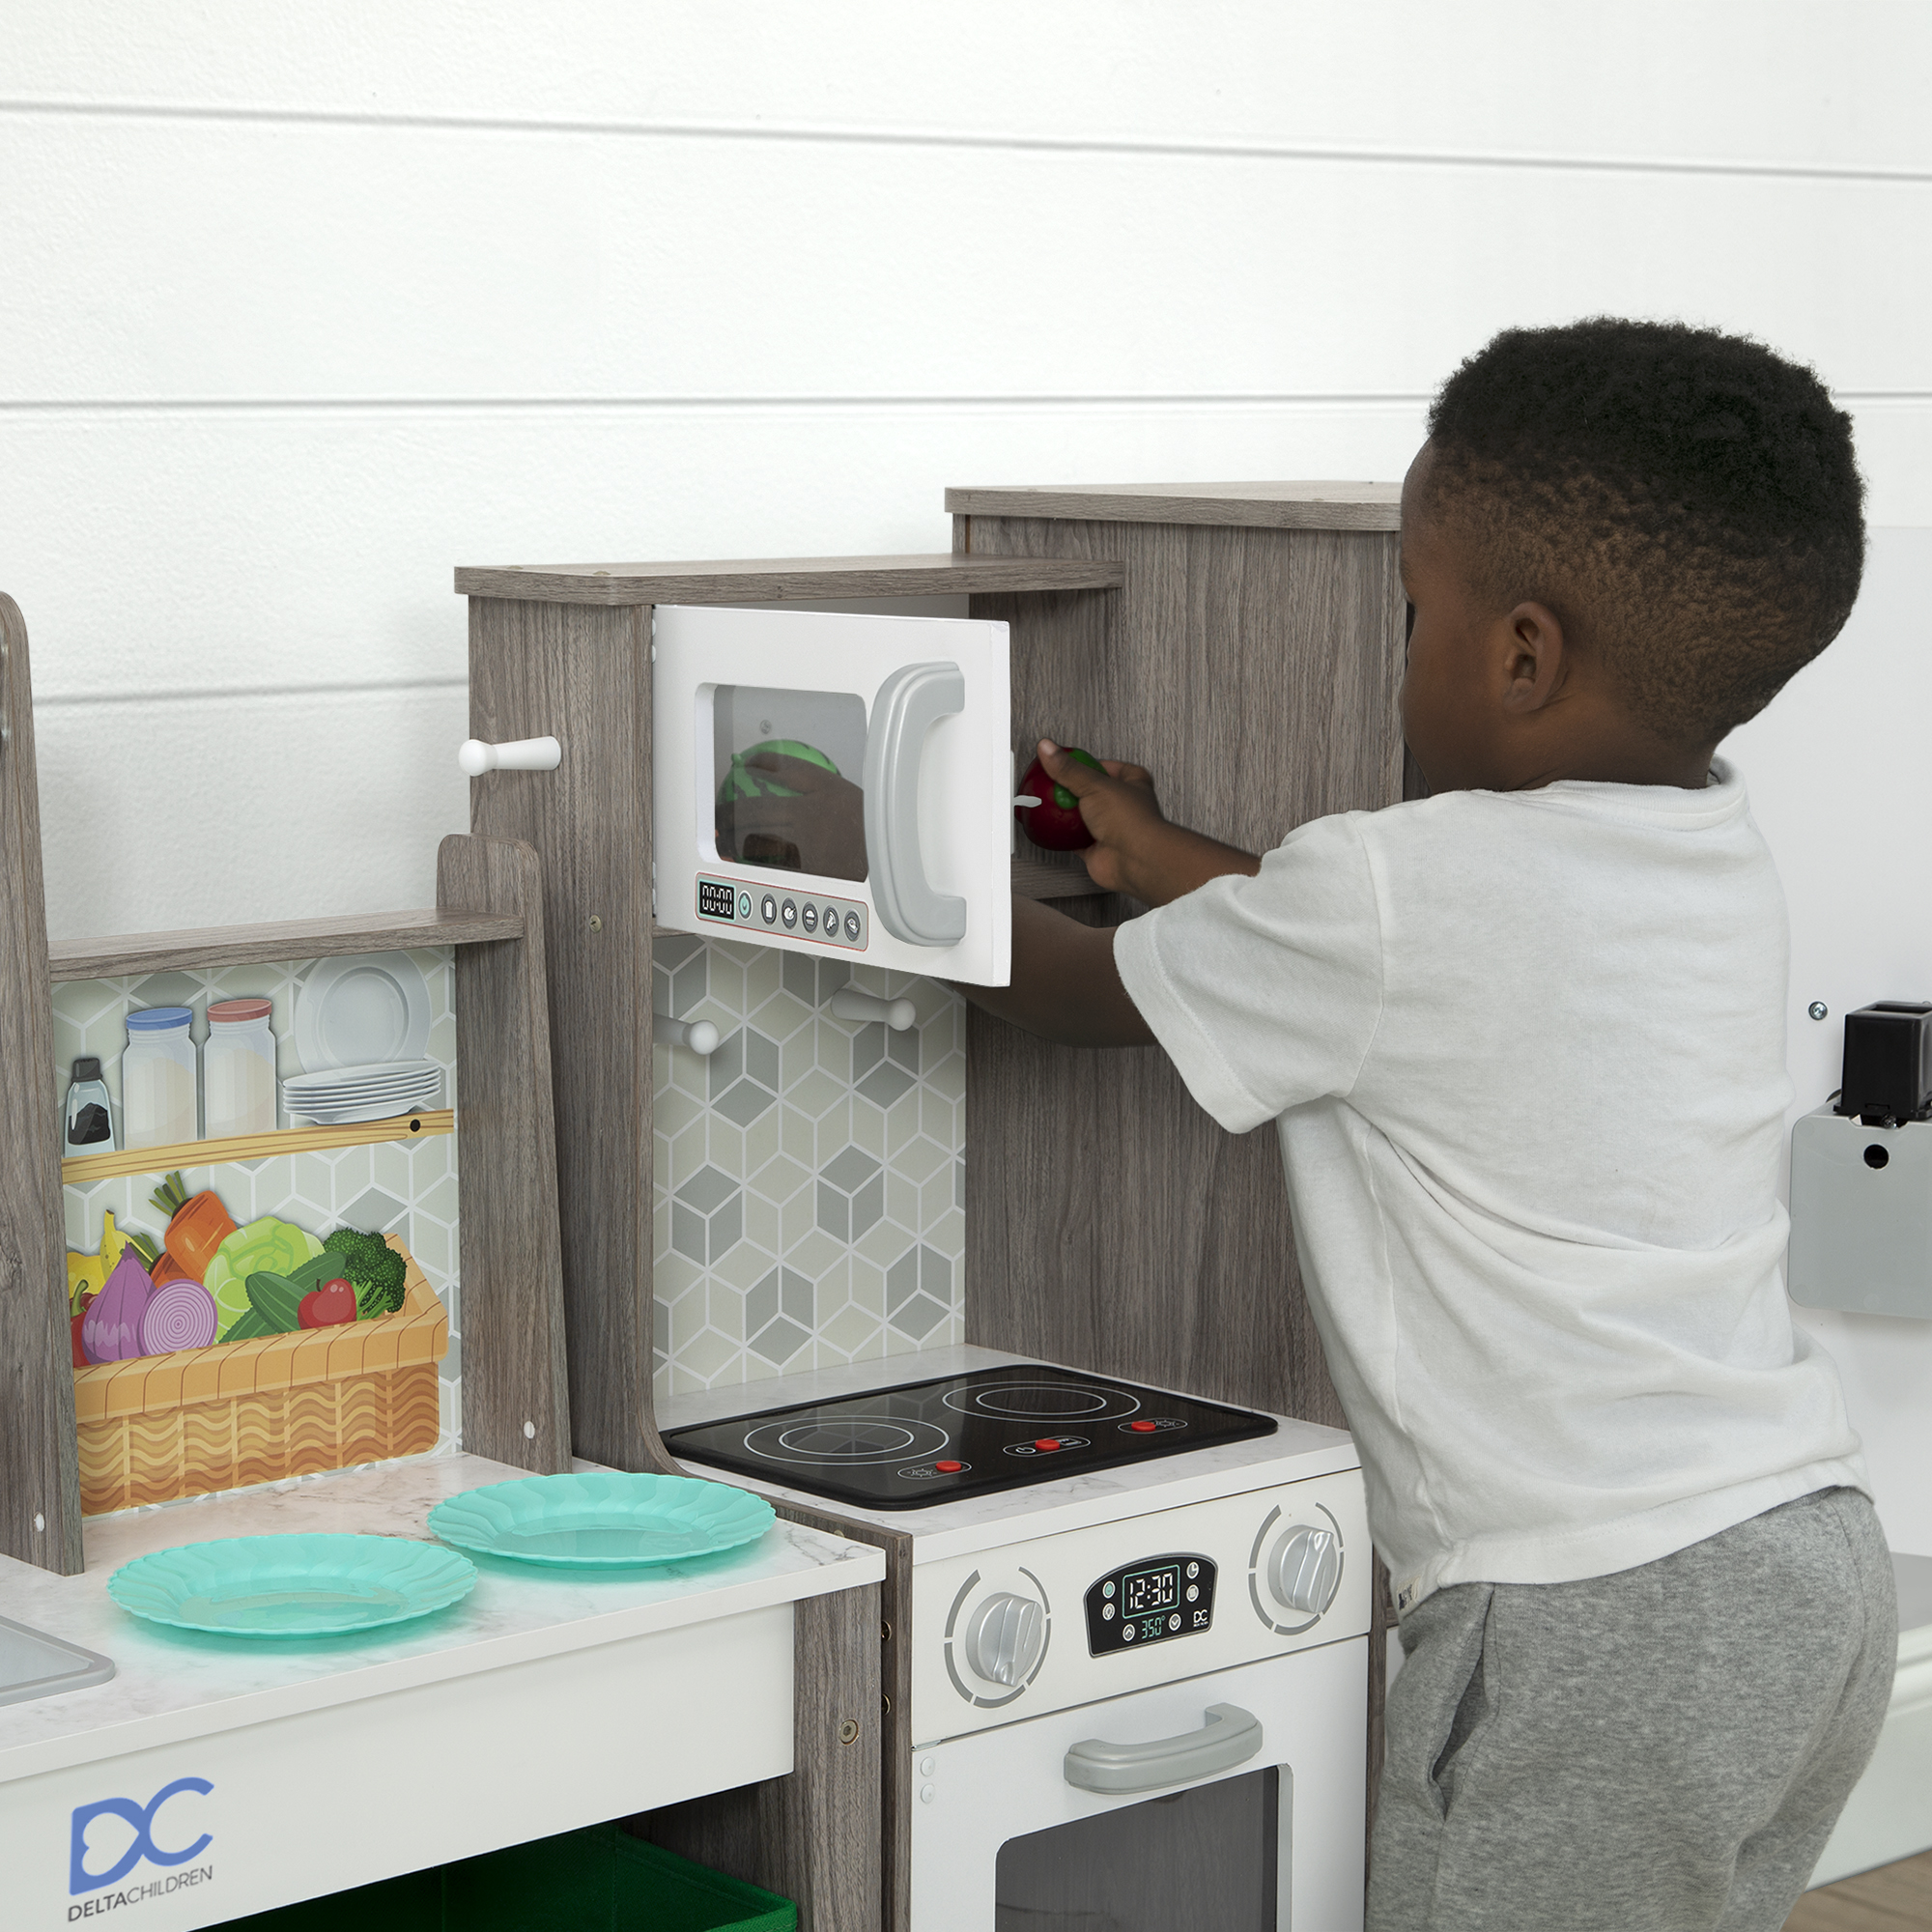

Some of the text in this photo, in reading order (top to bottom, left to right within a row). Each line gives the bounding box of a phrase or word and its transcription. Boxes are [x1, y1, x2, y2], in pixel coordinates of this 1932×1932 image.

[1130, 1573, 1173, 1609] 12:30
[1193, 1609, 1208, 1623] DC
[70, 1776, 214, 1895] DC
